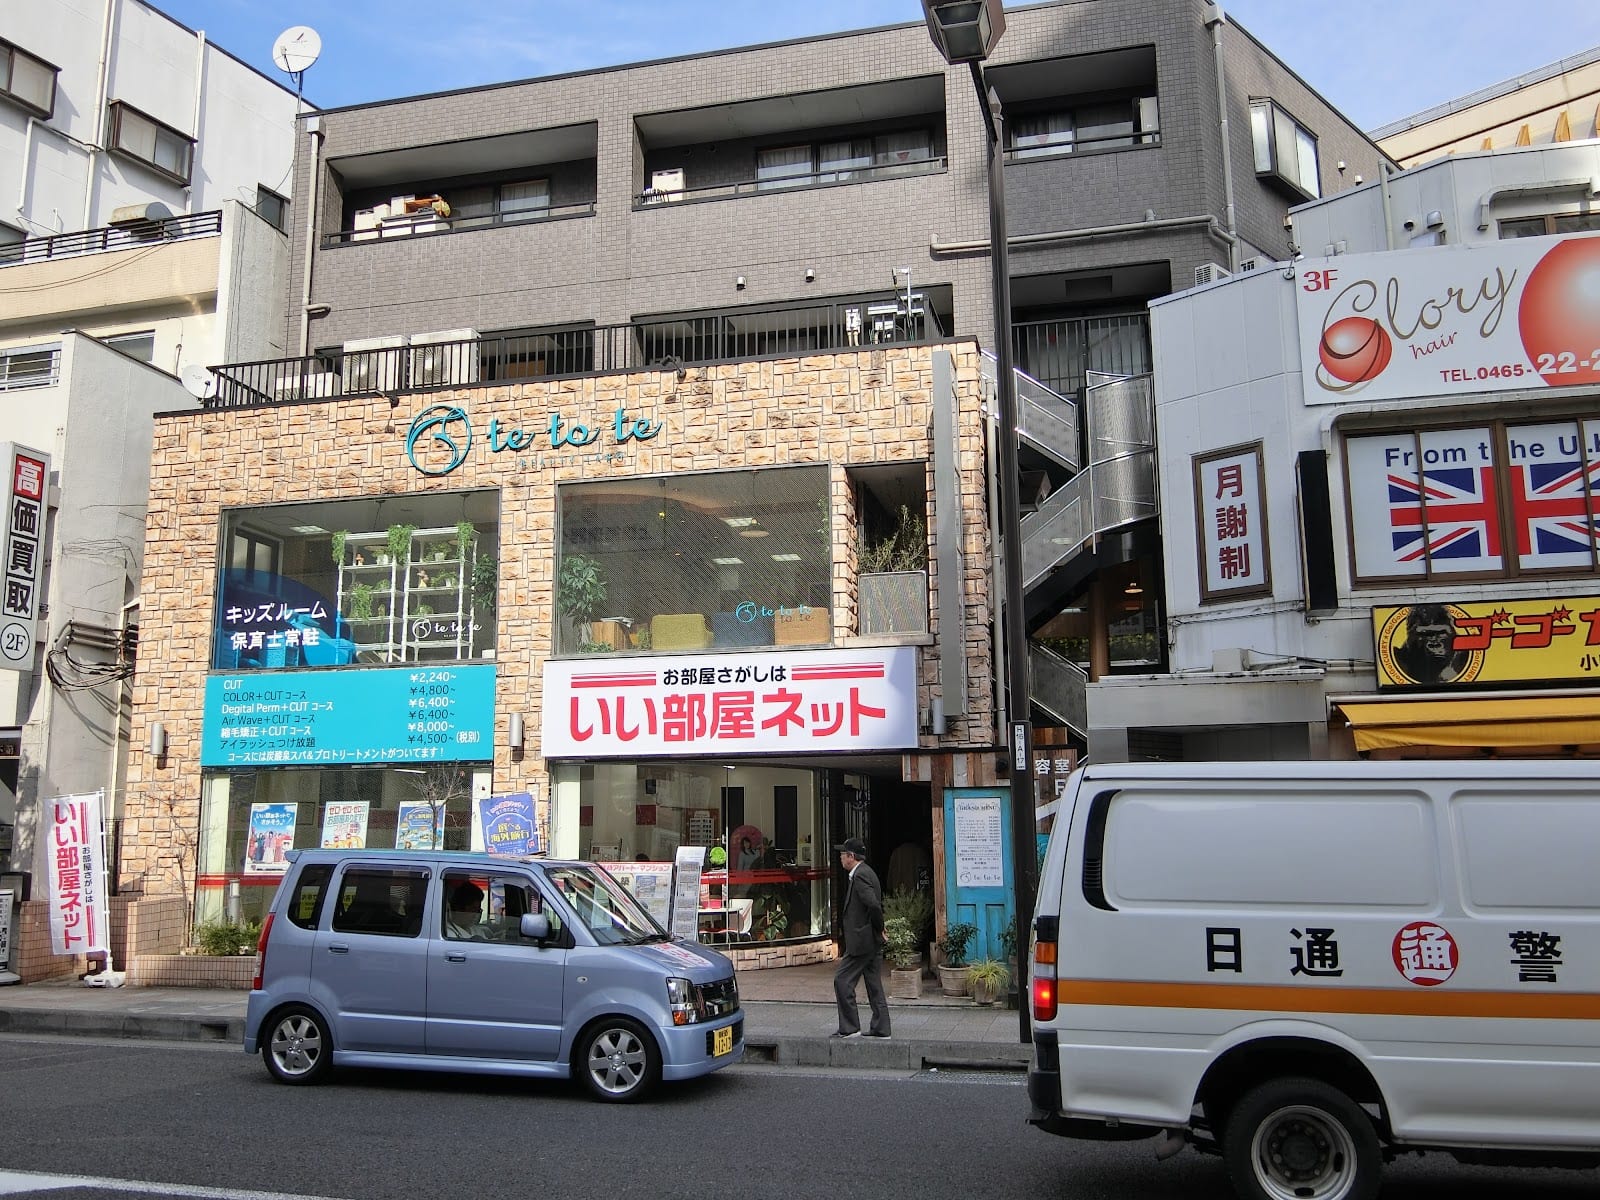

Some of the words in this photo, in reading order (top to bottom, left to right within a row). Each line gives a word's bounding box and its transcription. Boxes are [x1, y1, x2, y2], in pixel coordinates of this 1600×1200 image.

[1303, 269, 1338, 292] 3F
[1408, 331, 1458, 360] hair
[487, 418, 536, 453] te
[547, 413, 600, 449] to
[612, 407, 663, 443] te
[1385, 444, 1475, 467] From
[1478, 440, 1545, 460] the
[1215, 463, 1251, 580] 月謝制
[7, 460, 42, 614] 高価買取
[226, 601, 327, 624] キッズルーム
[5, 632, 26, 651] 2F
[231, 627, 320, 650] 保育士常駐
[1579, 654, 1600, 671] 小
[223, 679, 244, 690] CUT
[663, 665, 788, 686] お部屋さがしは
[286, 690, 307, 700] コース
[222, 703, 254, 716] Degital
[311, 701, 334, 711] コース
[222, 716, 236, 725] Air
[294, 714, 315, 723] コース
[570, 687, 886, 742] いい部屋ネット
[290, 726, 311, 735] コース
[220, 737, 316, 750] アイラッシュつけ放題
[55, 803, 82, 950] いい部屋ネット
[82, 847, 94, 904] お部屋さがしは
[1508, 931, 1564, 983] 警
